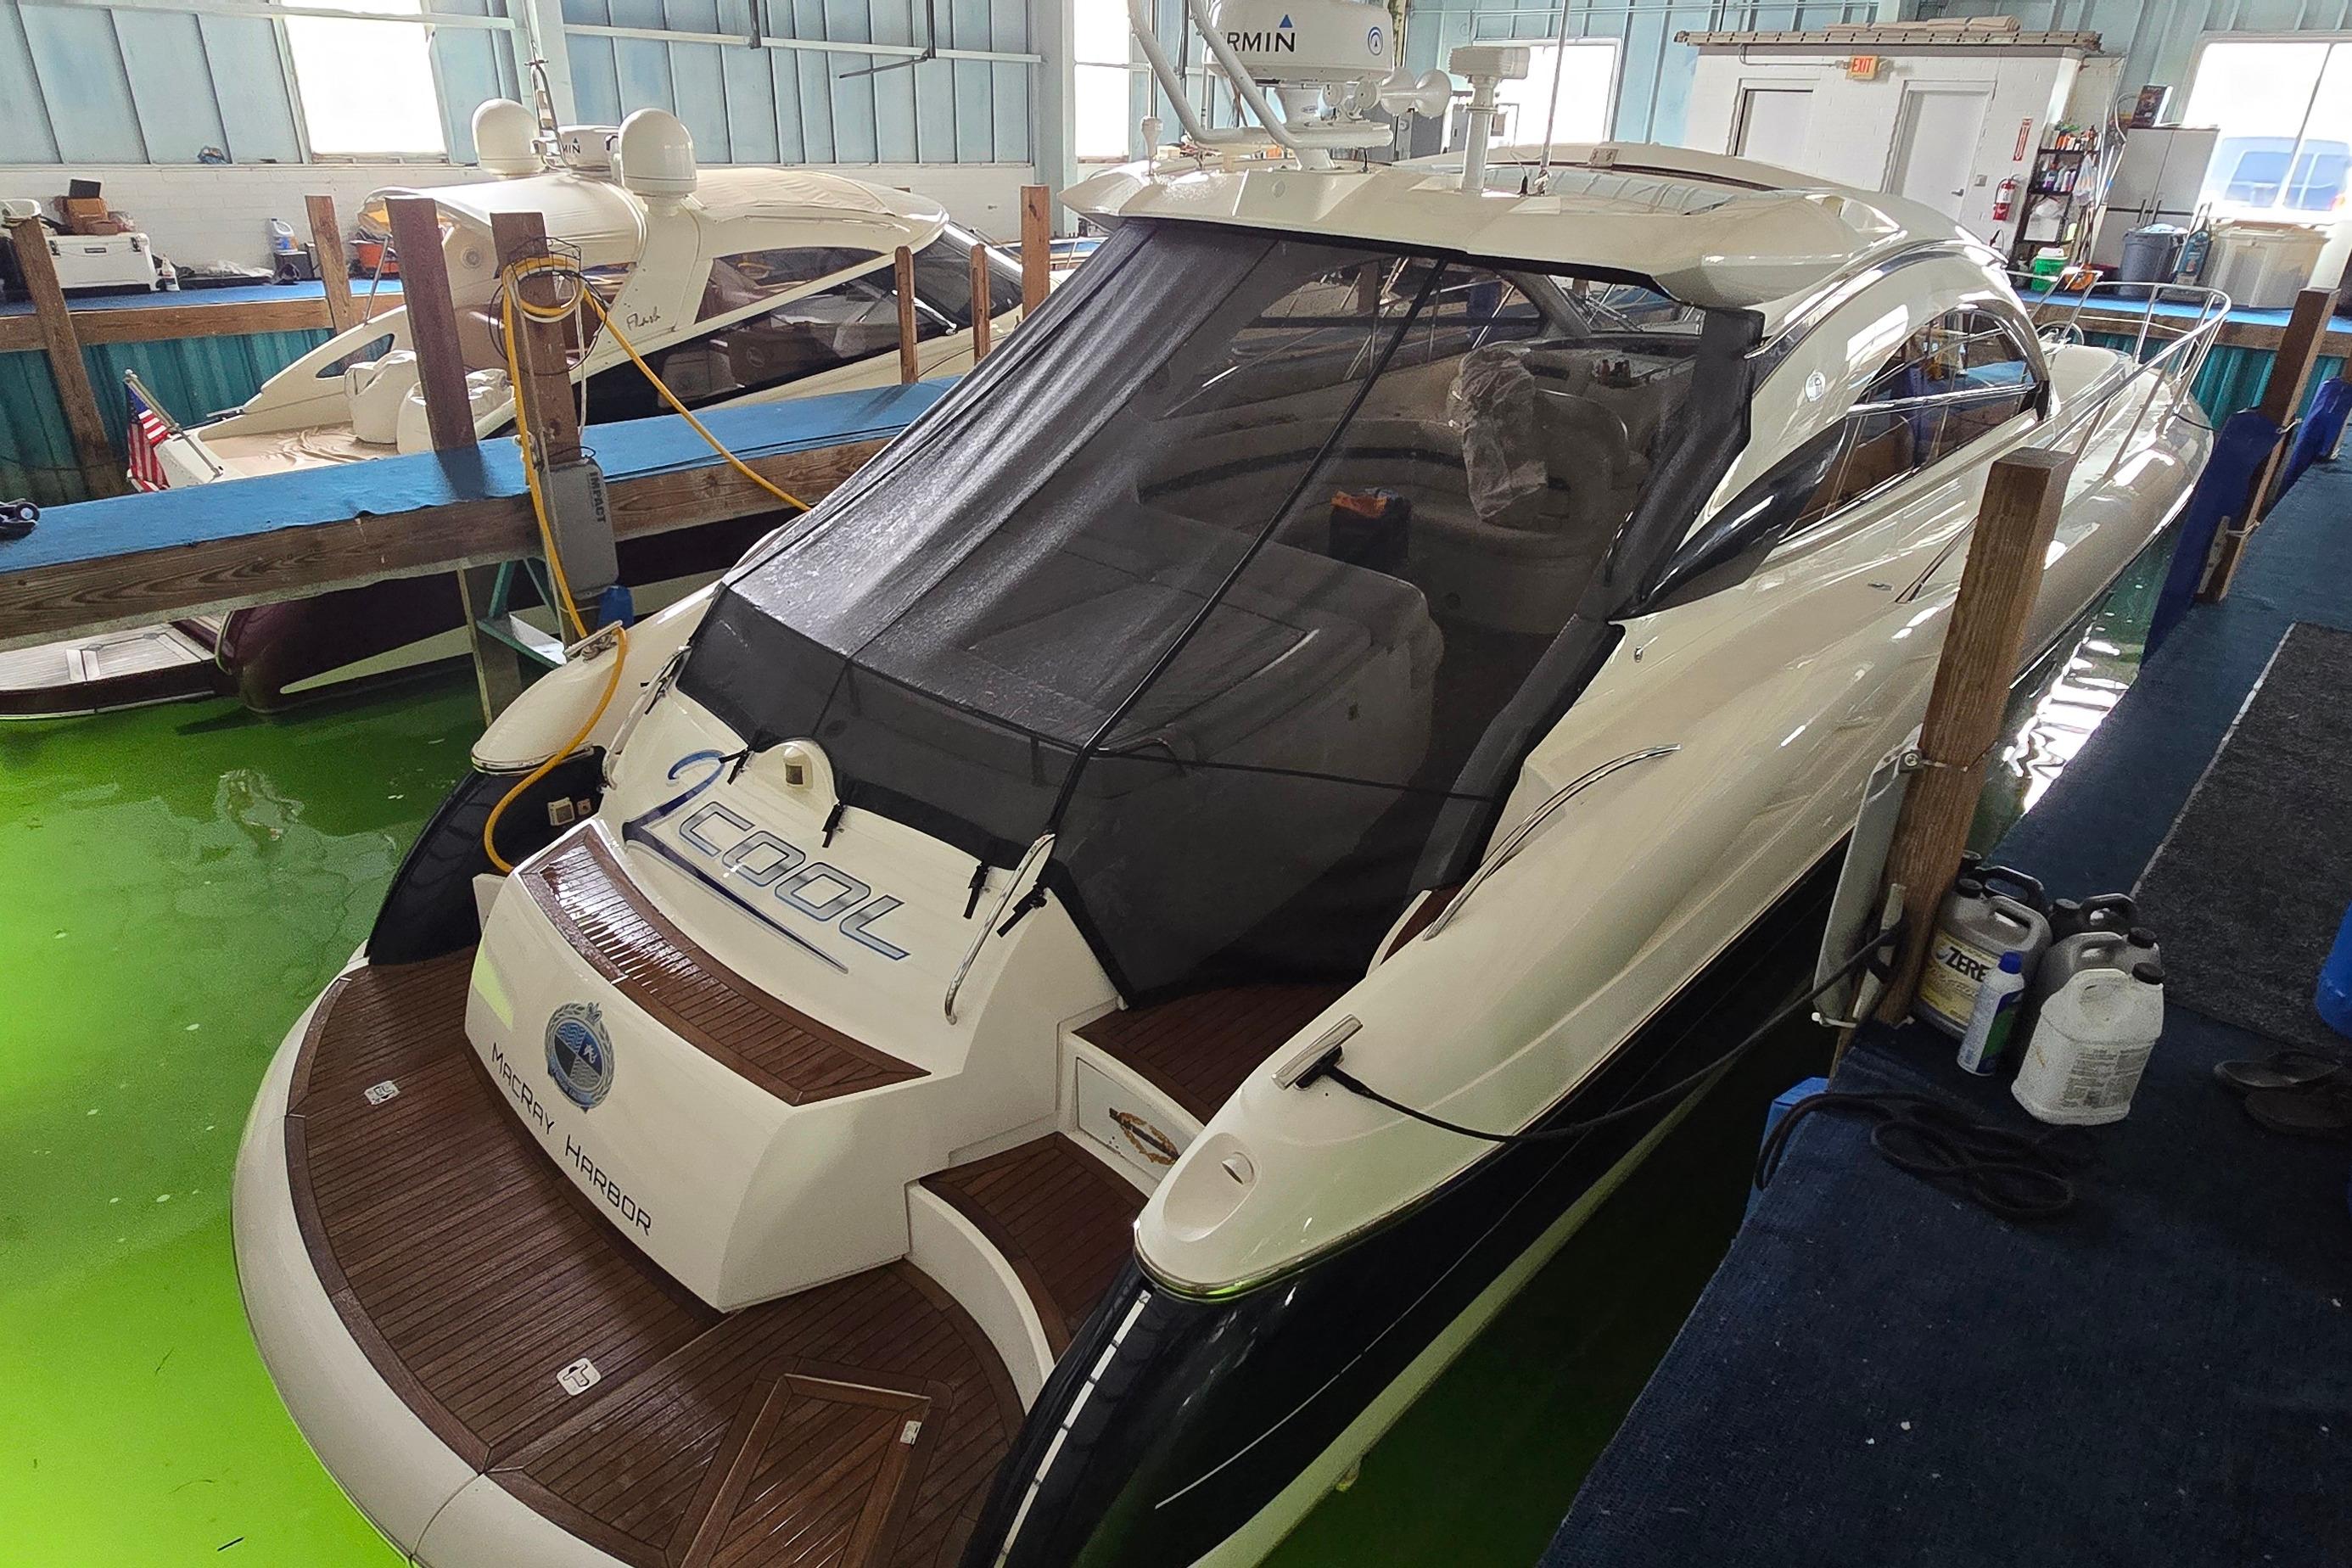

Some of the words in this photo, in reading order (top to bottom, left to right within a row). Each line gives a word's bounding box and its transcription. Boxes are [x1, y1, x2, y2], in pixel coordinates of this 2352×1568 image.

[1224, 31, 1296, 53] RMIN
[1851, 58, 1873, 73] EXIT
[562, 144, 581, 154] MIN
[589, 471, 606, 524] IMPACT
[680, 801, 910, 960] COOL
[1946, 946, 1991, 983] ZERE
[565, 1134, 652, 1235] HARBOR
